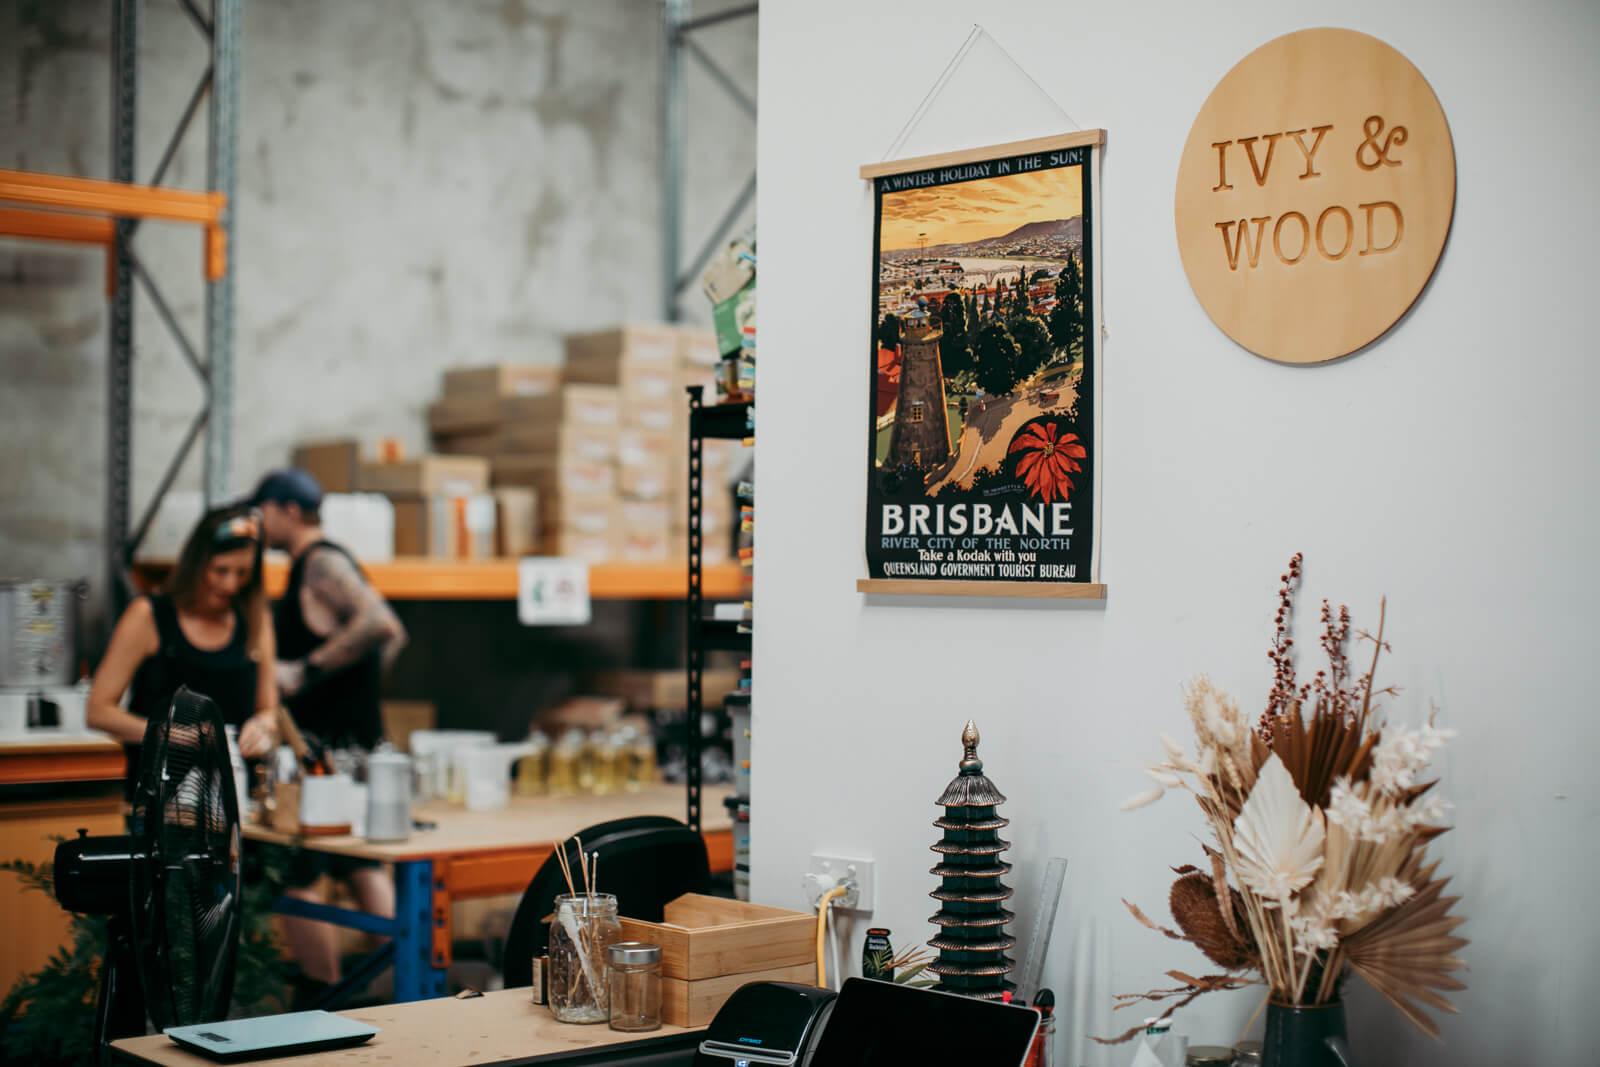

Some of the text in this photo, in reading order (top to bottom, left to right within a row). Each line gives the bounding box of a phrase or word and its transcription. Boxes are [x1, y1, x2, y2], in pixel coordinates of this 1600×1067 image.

[880, 151, 1083, 191] A WINTER HOLIDAY IN THE SUN!
[1211, 115, 1409, 192] IVY &
[1215, 200, 1405, 271] WOOD
[881, 502, 1074, 537] BRISBANE
[881, 537, 1071, 550] RIVER CITY OF THE NORTH
[918, 549, 1037, 565] Take a Kodak with you
[883, 562, 1076, 579] QUEENSLAND GOVERNMENT TOURIST BUREAU
